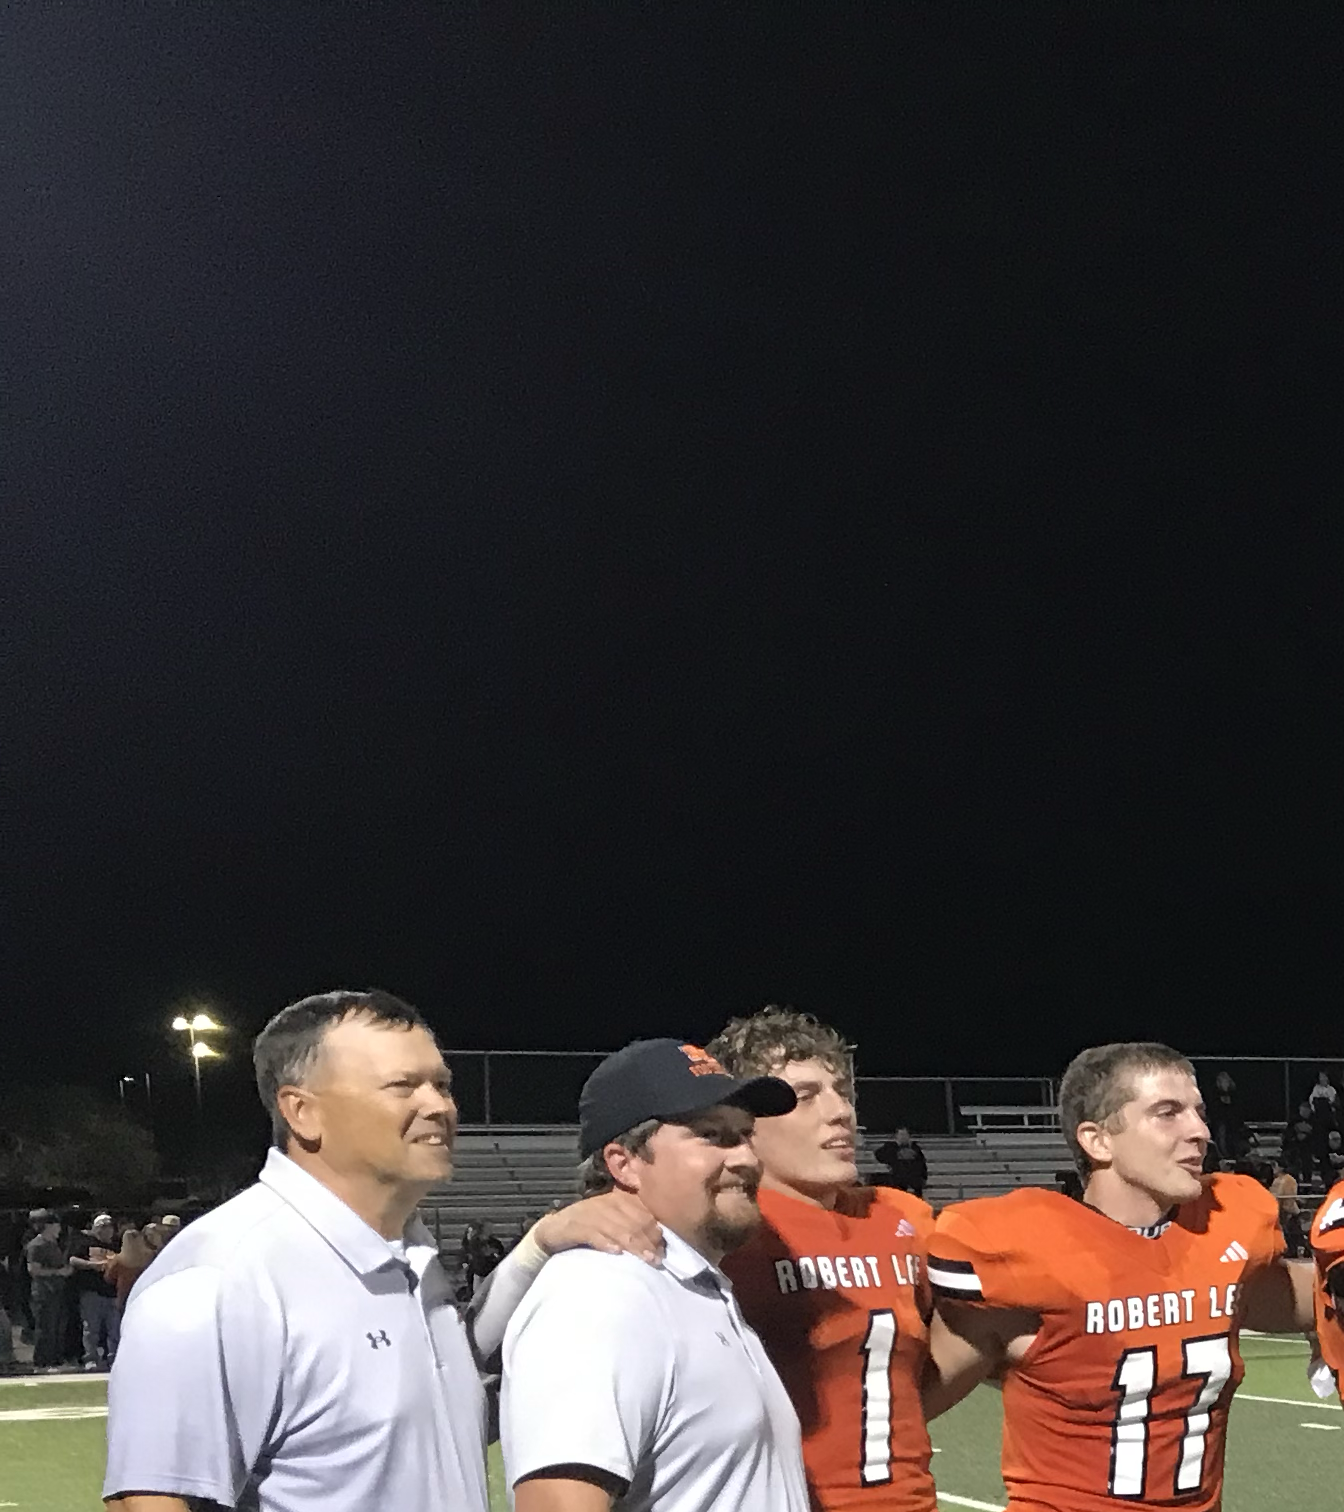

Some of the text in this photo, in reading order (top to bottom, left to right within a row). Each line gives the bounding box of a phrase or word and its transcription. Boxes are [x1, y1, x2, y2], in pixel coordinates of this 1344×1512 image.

[774, 1255, 882, 1295] ROBERT
[1085, 1288, 1197, 1335] ROBERT
[859, 1308, 897, 1488] 1
[1107, 1332, 1233, 1500] 17
